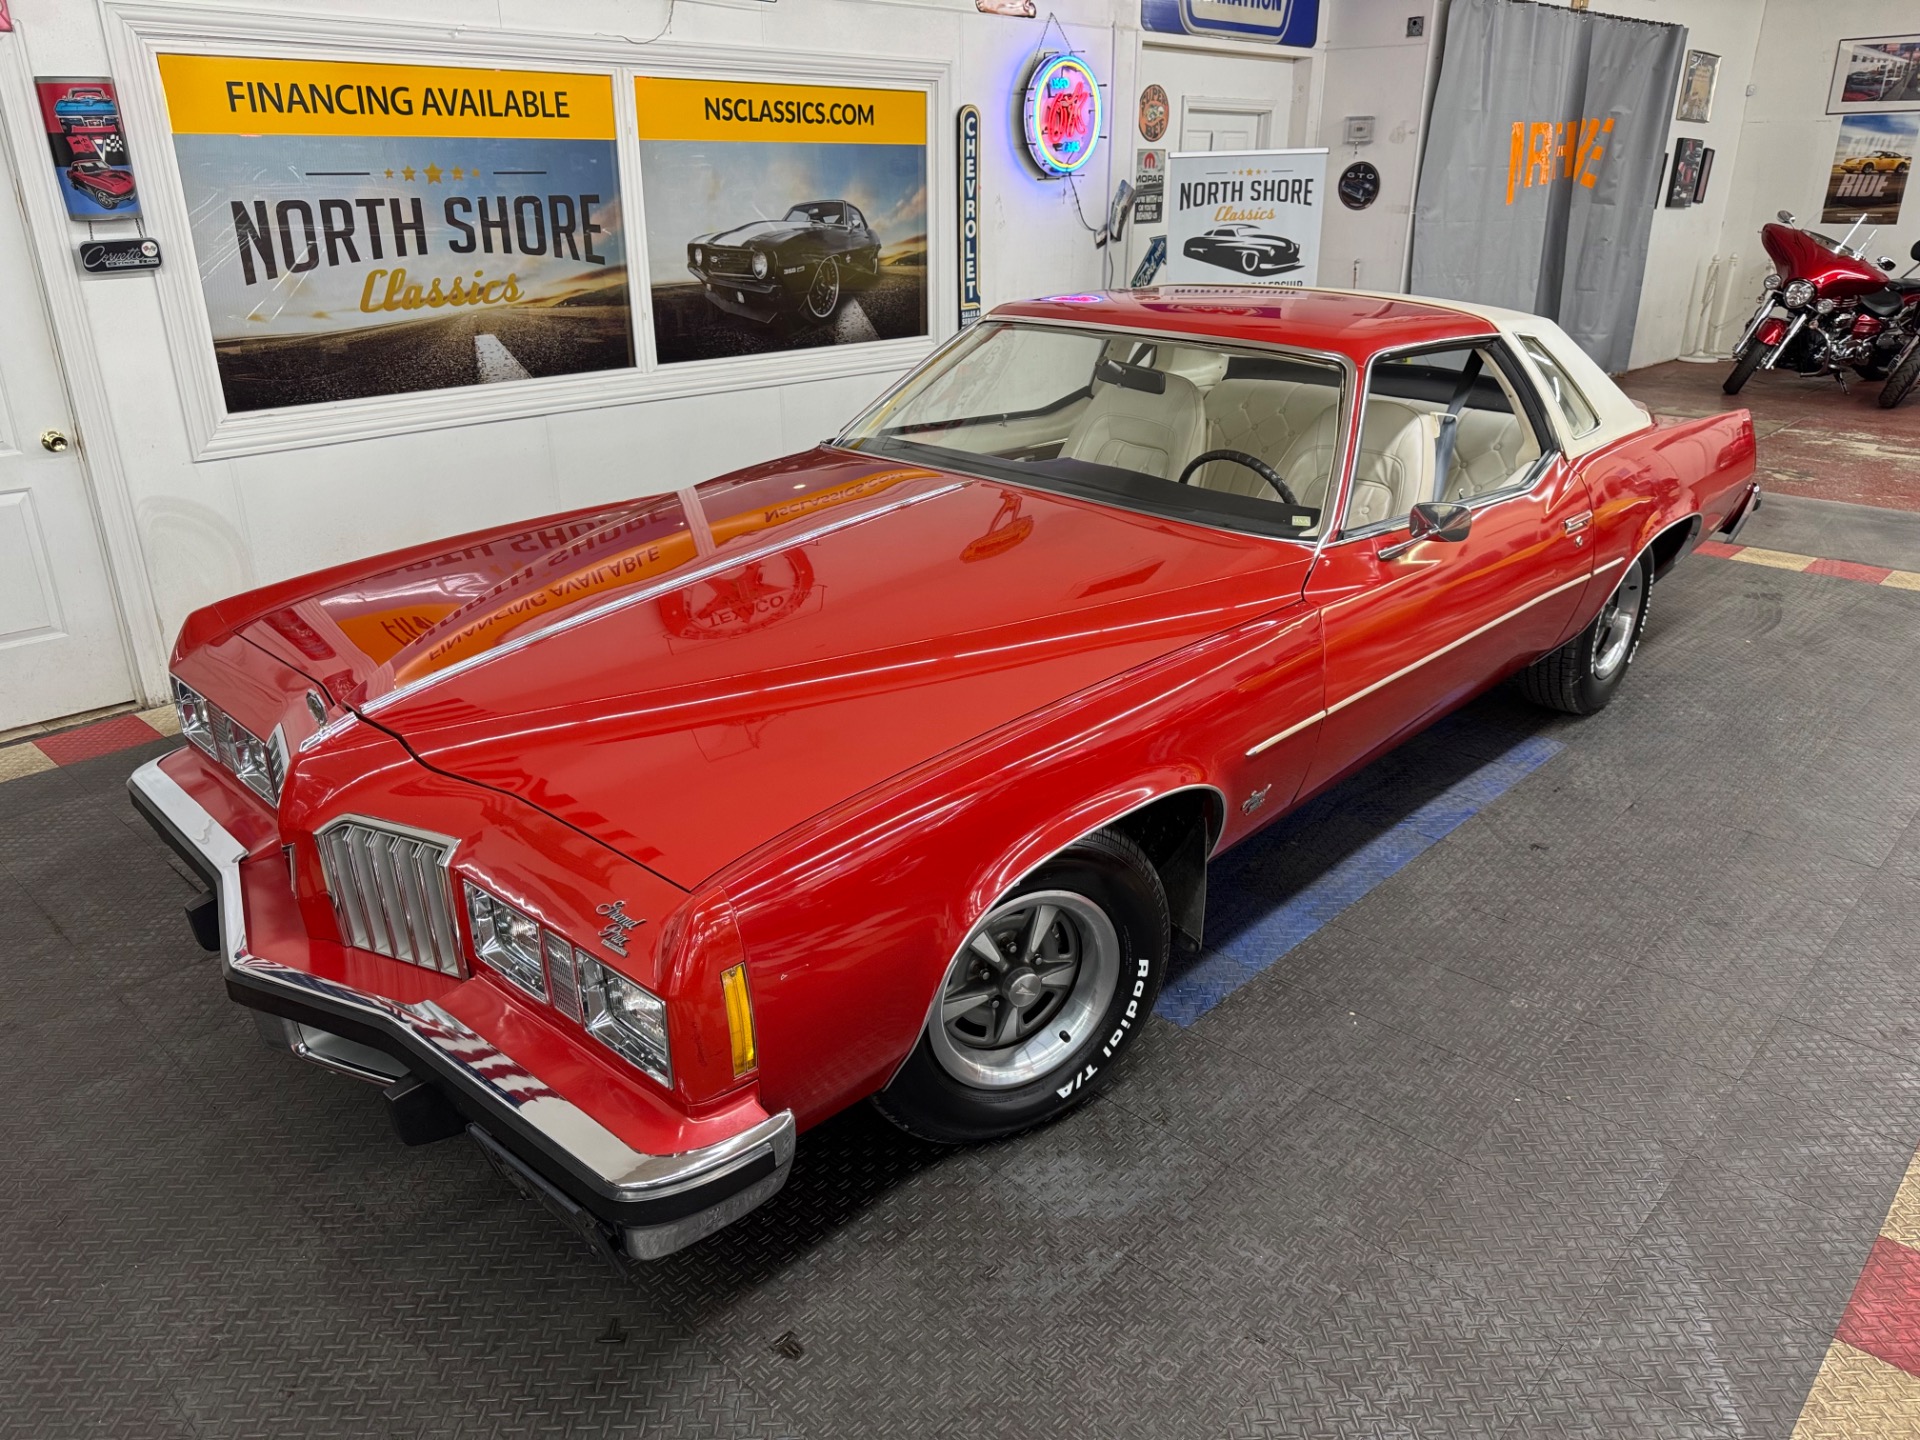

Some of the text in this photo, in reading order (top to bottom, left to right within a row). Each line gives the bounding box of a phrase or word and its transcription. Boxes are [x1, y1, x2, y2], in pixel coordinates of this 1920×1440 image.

[226, 81, 570, 118] FINANCING AVAILABLE
[704, 97, 874, 126] NSCLASSICS.COM
[1144, 119, 1164, 138] BEE
[1136, 175, 1163, 183] MOPAR
[1346, 172, 1375, 180] GTO
[1836, 173, 1888, 197] RIDE
[965, 117, 977, 298] CHEVROLET
[1180, 178, 1314, 210] NORTH SHORE
[1214, 206, 1275, 222] Classics
[231, 194, 605, 286] NORTH SHORE
[84, 246, 144, 268] Corvette
[360, 267, 525, 313] Classics
[596, 900, 647, 930] Grand
[597, 922, 631, 947] Prix
[1056, 958, 1149, 1099] Radial T/A
